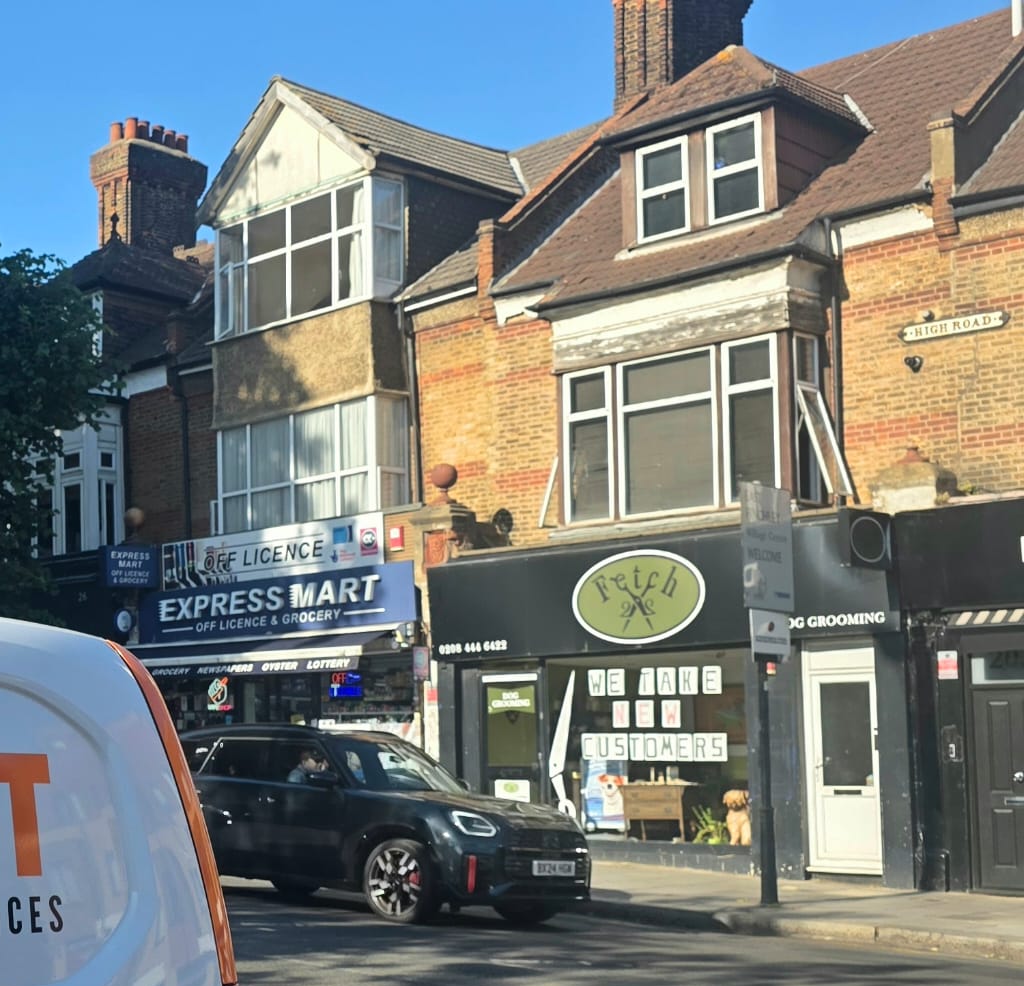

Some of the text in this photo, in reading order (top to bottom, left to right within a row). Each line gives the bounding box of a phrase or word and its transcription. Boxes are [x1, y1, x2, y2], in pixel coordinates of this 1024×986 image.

[914, 315, 992, 337] HIGH ROAD
[110, 550, 150, 561] EXPRESS
[118, 560, 143, 569] MART
[204, 551, 237, 572] OFF
[242, 540, 324, 566] LICENCE
[159, 574, 380, 622] EXPRESS MART
[196, 608, 342, 633] OFF LICENCE & GROCERY
[807, 611, 886, 627] GROOMING
[439, 643, 462, 655] 0208
[152, 658, 351, 676] GROCERY NEWSPAPERS OYSTER LOTTERY
[590, 668, 719, 694] WE TAKE
[614, 702, 679, 725] NEW
[583, 736, 724, 759] CUSTOMERS
